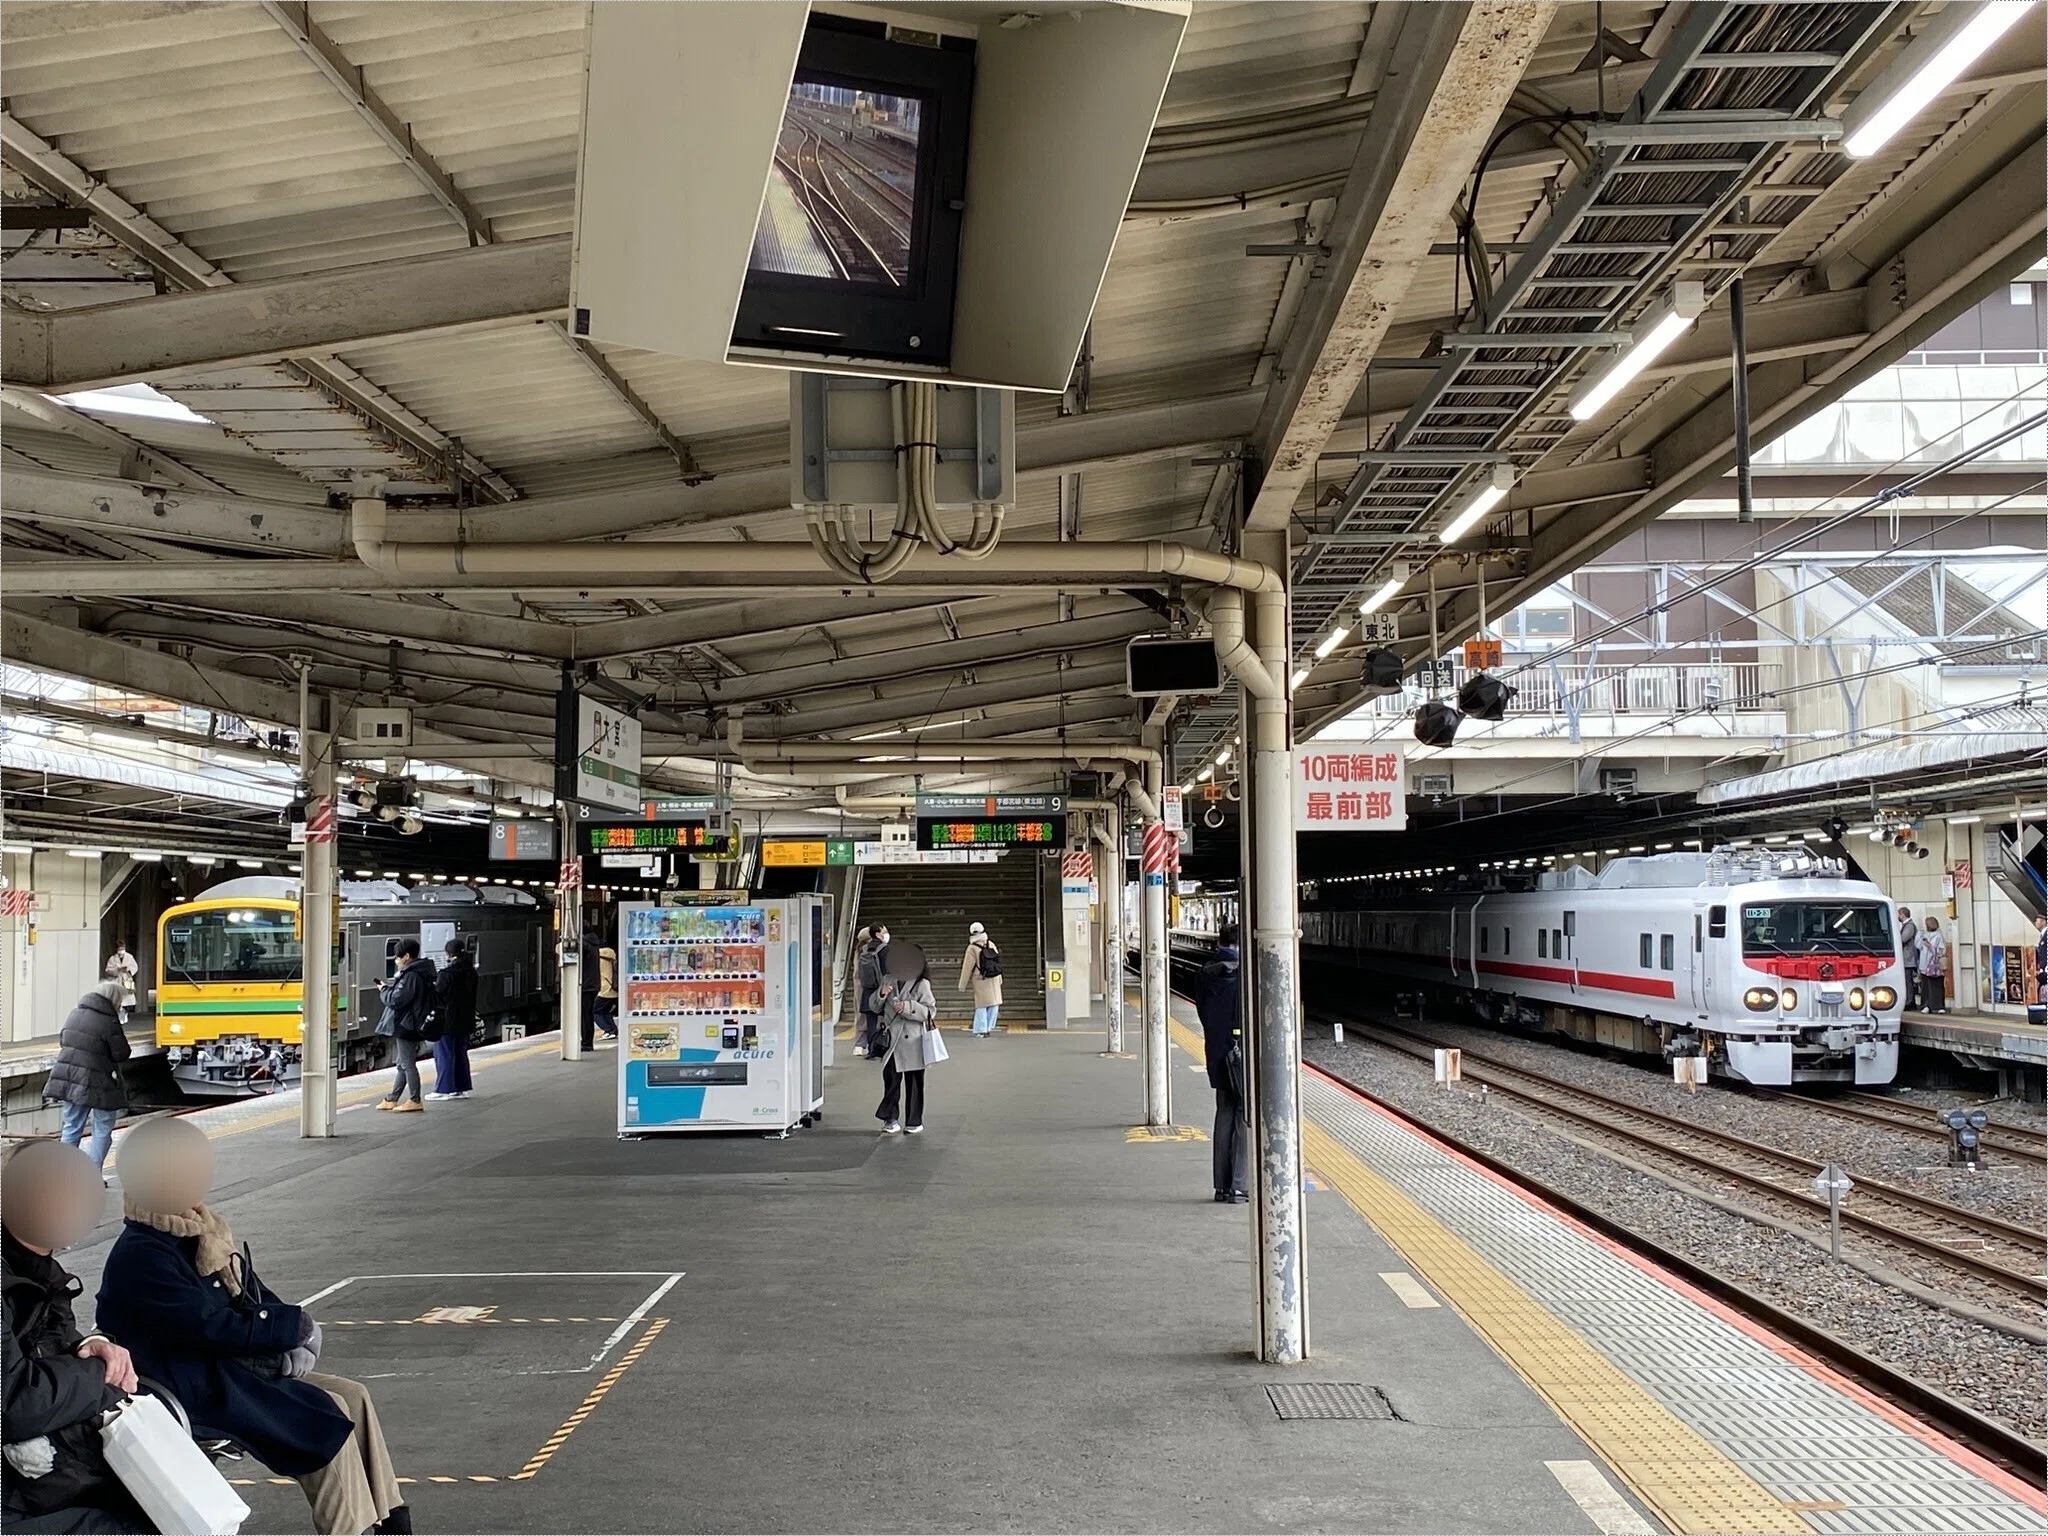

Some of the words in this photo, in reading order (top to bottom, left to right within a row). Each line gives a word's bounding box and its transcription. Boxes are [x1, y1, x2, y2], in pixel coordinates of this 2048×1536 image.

[1372, 614, 1389, 623] 10
[1365, 623, 1396, 640] 東北
[1426, 660, 1444, 670] 10
[1469, 651, 1503, 667] 高崎
[1421, 670, 1452, 687] 回送
[1300, 754, 1398, 782] 10両編成
[1051, 797, 1061, 812] 9
[1306, 791, 1393, 820] 最前部
[495, 824, 505, 839] 8
[1050, 971, 1061, 983] D
[505, 1026, 523, 1041] 75
[732, 1049, 775, 1060] acure
